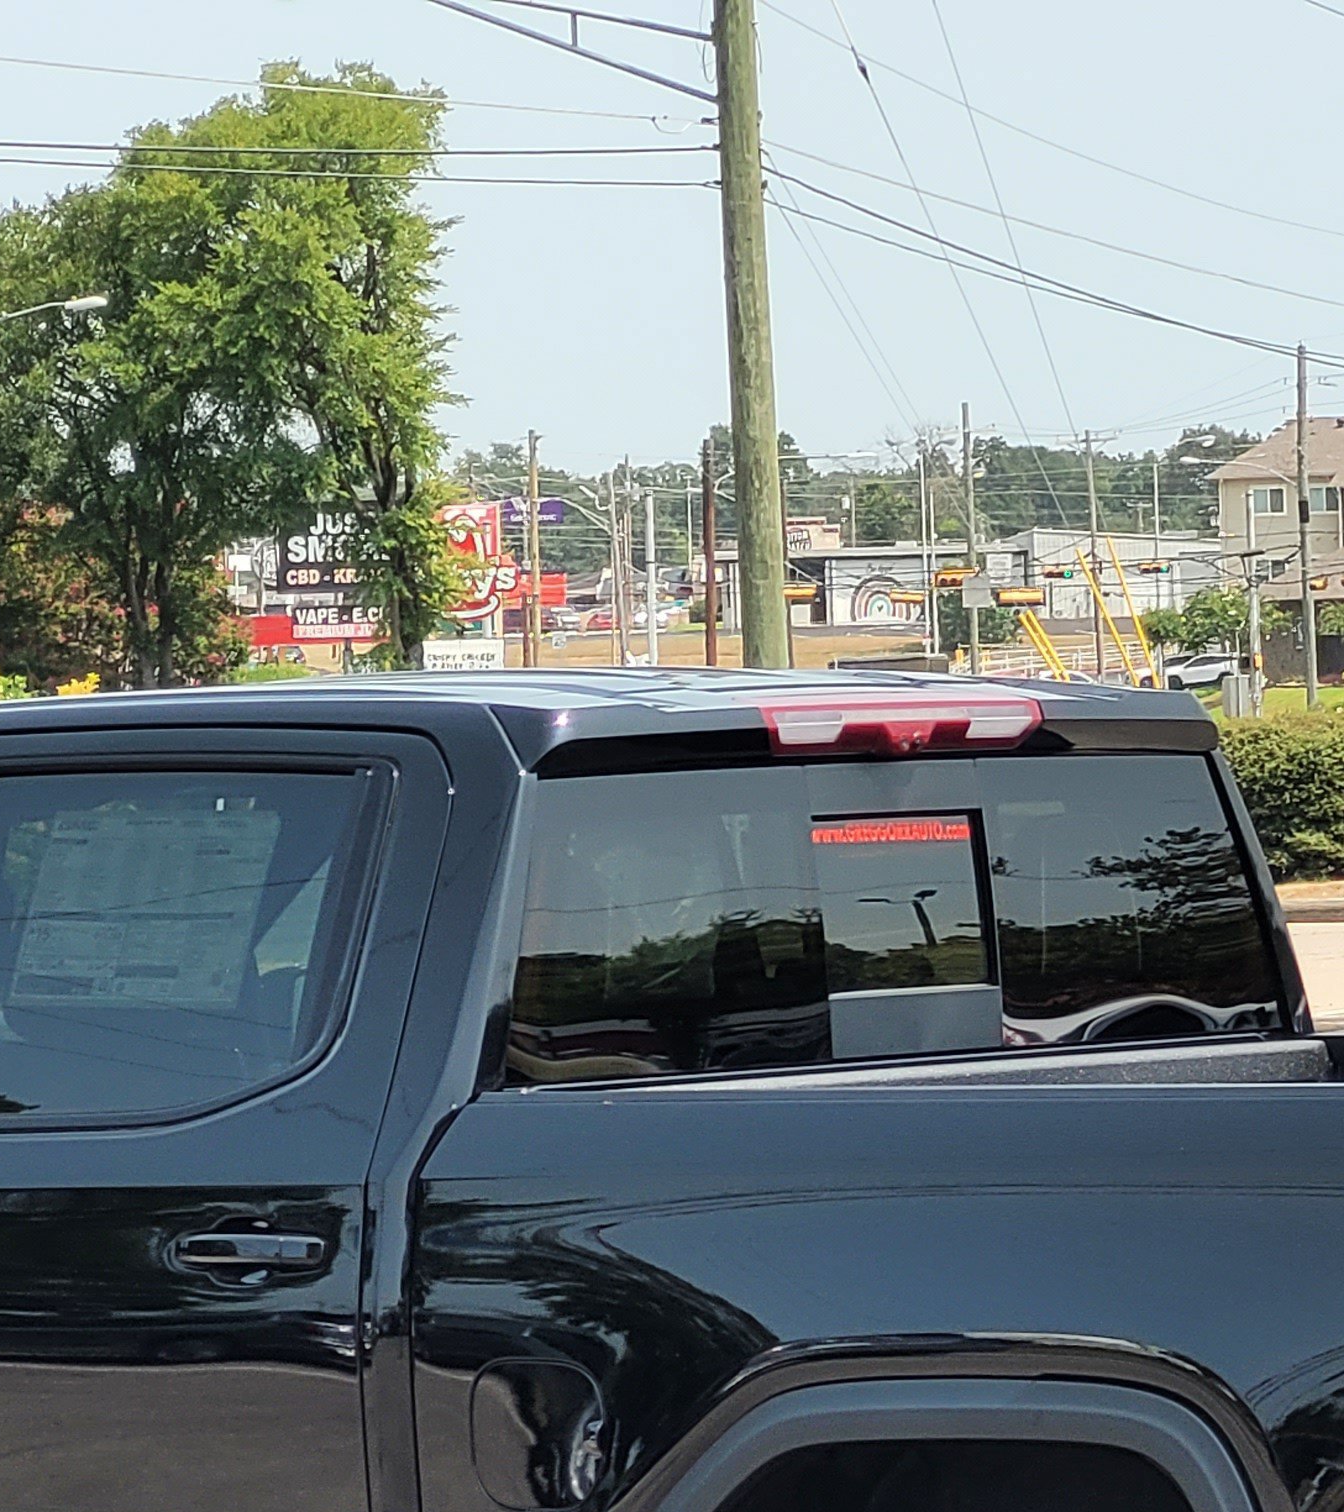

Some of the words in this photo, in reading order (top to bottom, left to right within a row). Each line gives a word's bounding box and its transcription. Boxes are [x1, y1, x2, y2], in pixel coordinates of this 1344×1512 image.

[309, 512, 372, 536] JUS
[286, 569, 320, 586] CBD
[296, 608, 339, 625] VAPE
